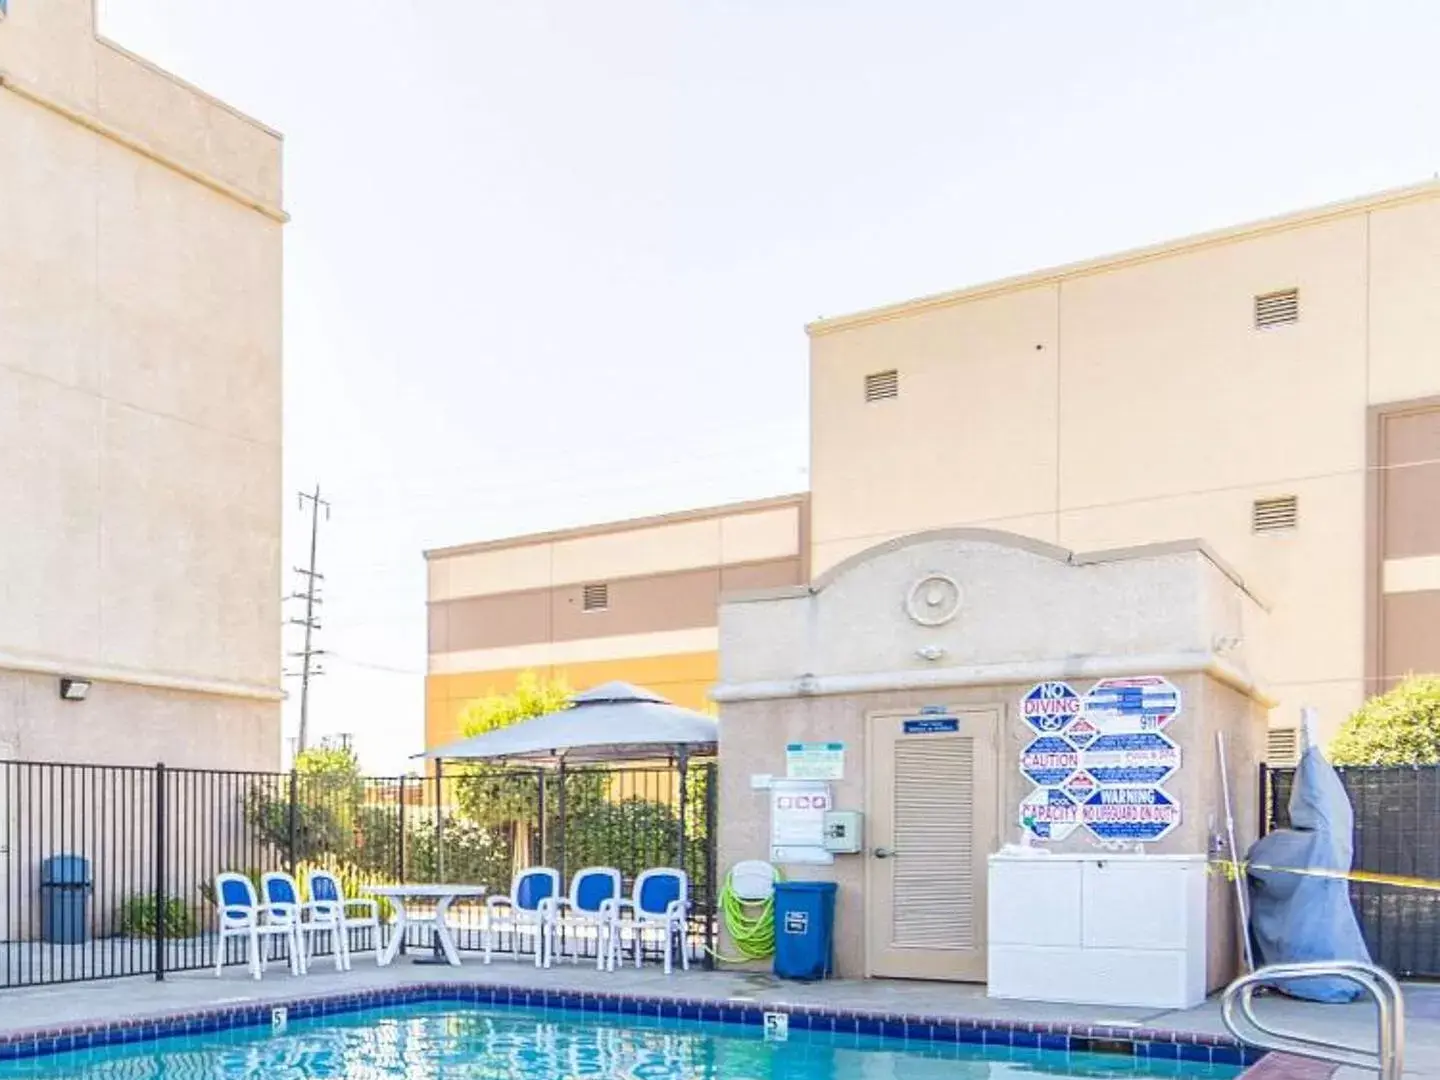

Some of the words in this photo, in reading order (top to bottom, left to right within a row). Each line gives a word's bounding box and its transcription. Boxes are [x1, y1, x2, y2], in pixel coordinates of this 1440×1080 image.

[1041, 683, 1065, 699] NO
[1024, 698, 1080, 714] DIVING
[1140, 715, 1157, 730] 911
[1023, 754, 1078, 767] CAUTION
[1101, 789, 1155, 805] WARNING
[1023, 805, 1077, 820] CAPACITY
[767, 1015, 778, 1029] 5
